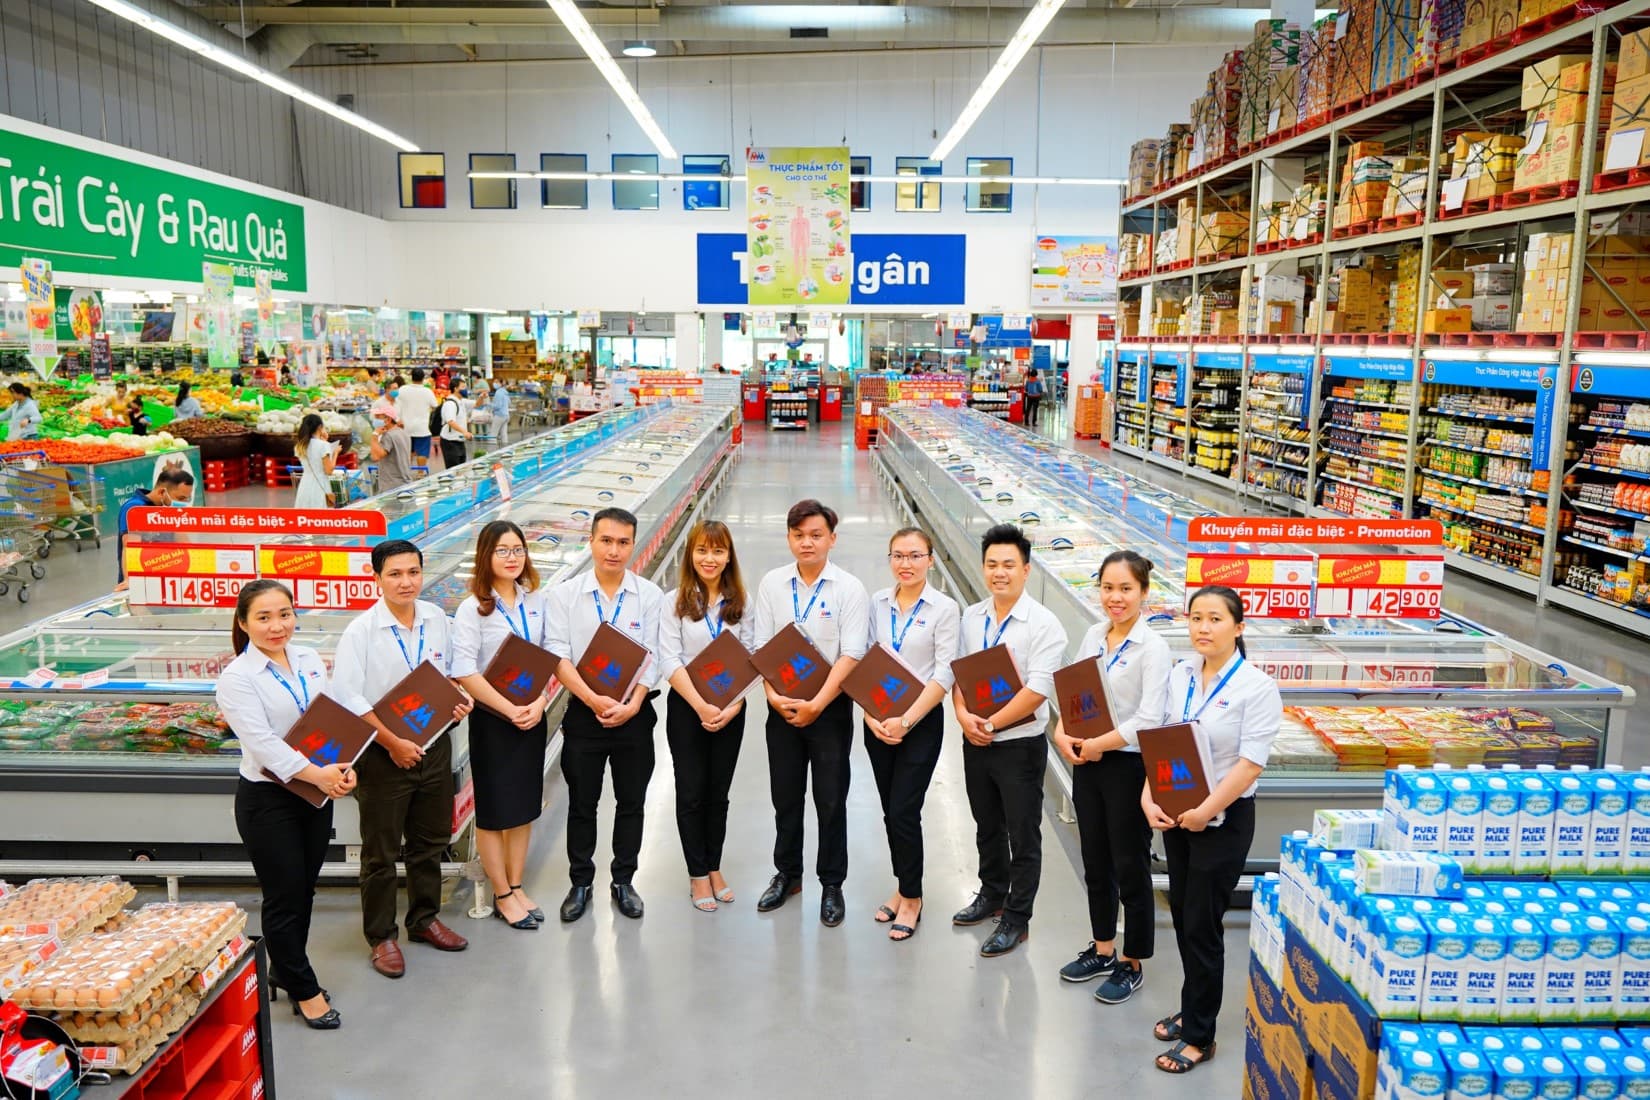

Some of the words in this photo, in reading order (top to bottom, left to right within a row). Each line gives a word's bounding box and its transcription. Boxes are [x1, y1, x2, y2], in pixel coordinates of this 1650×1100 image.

[826, 161, 844, 172] TỐT
[77, 175, 145, 258] Cây
[157, 193, 180, 244] &
[188, 198, 238, 254] Rau
[245, 211, 288, 262] Quả
[146, 511, 198, 527] Khuyến
[202, 512, 226, 526] mãi
[230, 514, 254, 529] đặc
[258, 513, 286, 529] biệt
[297, 515, 369, 529] Promotion
[1201, 521, 1254, 538] Khuyến
[1258, 523, 1284, 537] mãi
[1288, 523, 1313, 539] đặc
[1317, 524, 1345, 540] biệt
[1357, 525, 1432, 539] Promotion
[144, 553, 171, 567] KHUYẾN
[171, 549, 184, 558] MÃI
[277, 556, 304, 569] KHUYẾN
[304, 551, 317, 560] MÃI
[151, 559, 183, 571] PROMOTION
[285, 561, 316, 574] PROMOTION
[1204, 563, 1231, 578] KHUYẾN
[1232, 559, 1245, 569] MÃI
[1335, 565, 1363, 578] KHUYẾN
[1363, 560, 1377, 569] MÃI
[1210, 569, 1243, 582] PROMOTION
[1342, 570, 1374, 583] PROMOTION
[1413, 825, 1438, 834] PURE
[1449, 826, 1475, 834] PURE
[1485, 826, 1510, 834] PURE
[1521, 826, 1546, 835] PURE
[1559, 826, 1583, 834] PURE
[1389, 969, 1416, 978] PURE
[1431, 971, 1458, 979] PURE
[1468, 972, 1496, 980] PURE
[1508, 972, 1535, 980] PURE
[1547, 972, 1575, 980] PURE
[1585, 970, 1612, 979] PURE
[1388, 978, 1415, 986] MILK
[1430, 979, 1457, 987] MILK
[1467, 980, 1495, 988] MILK
[1507, 980, 1534, 988] MILK
[1547, 980, 1574, 988] MILK
[1584, 979, 1611, 987] MILK
[1622, 979, 1650, 987] MILK
